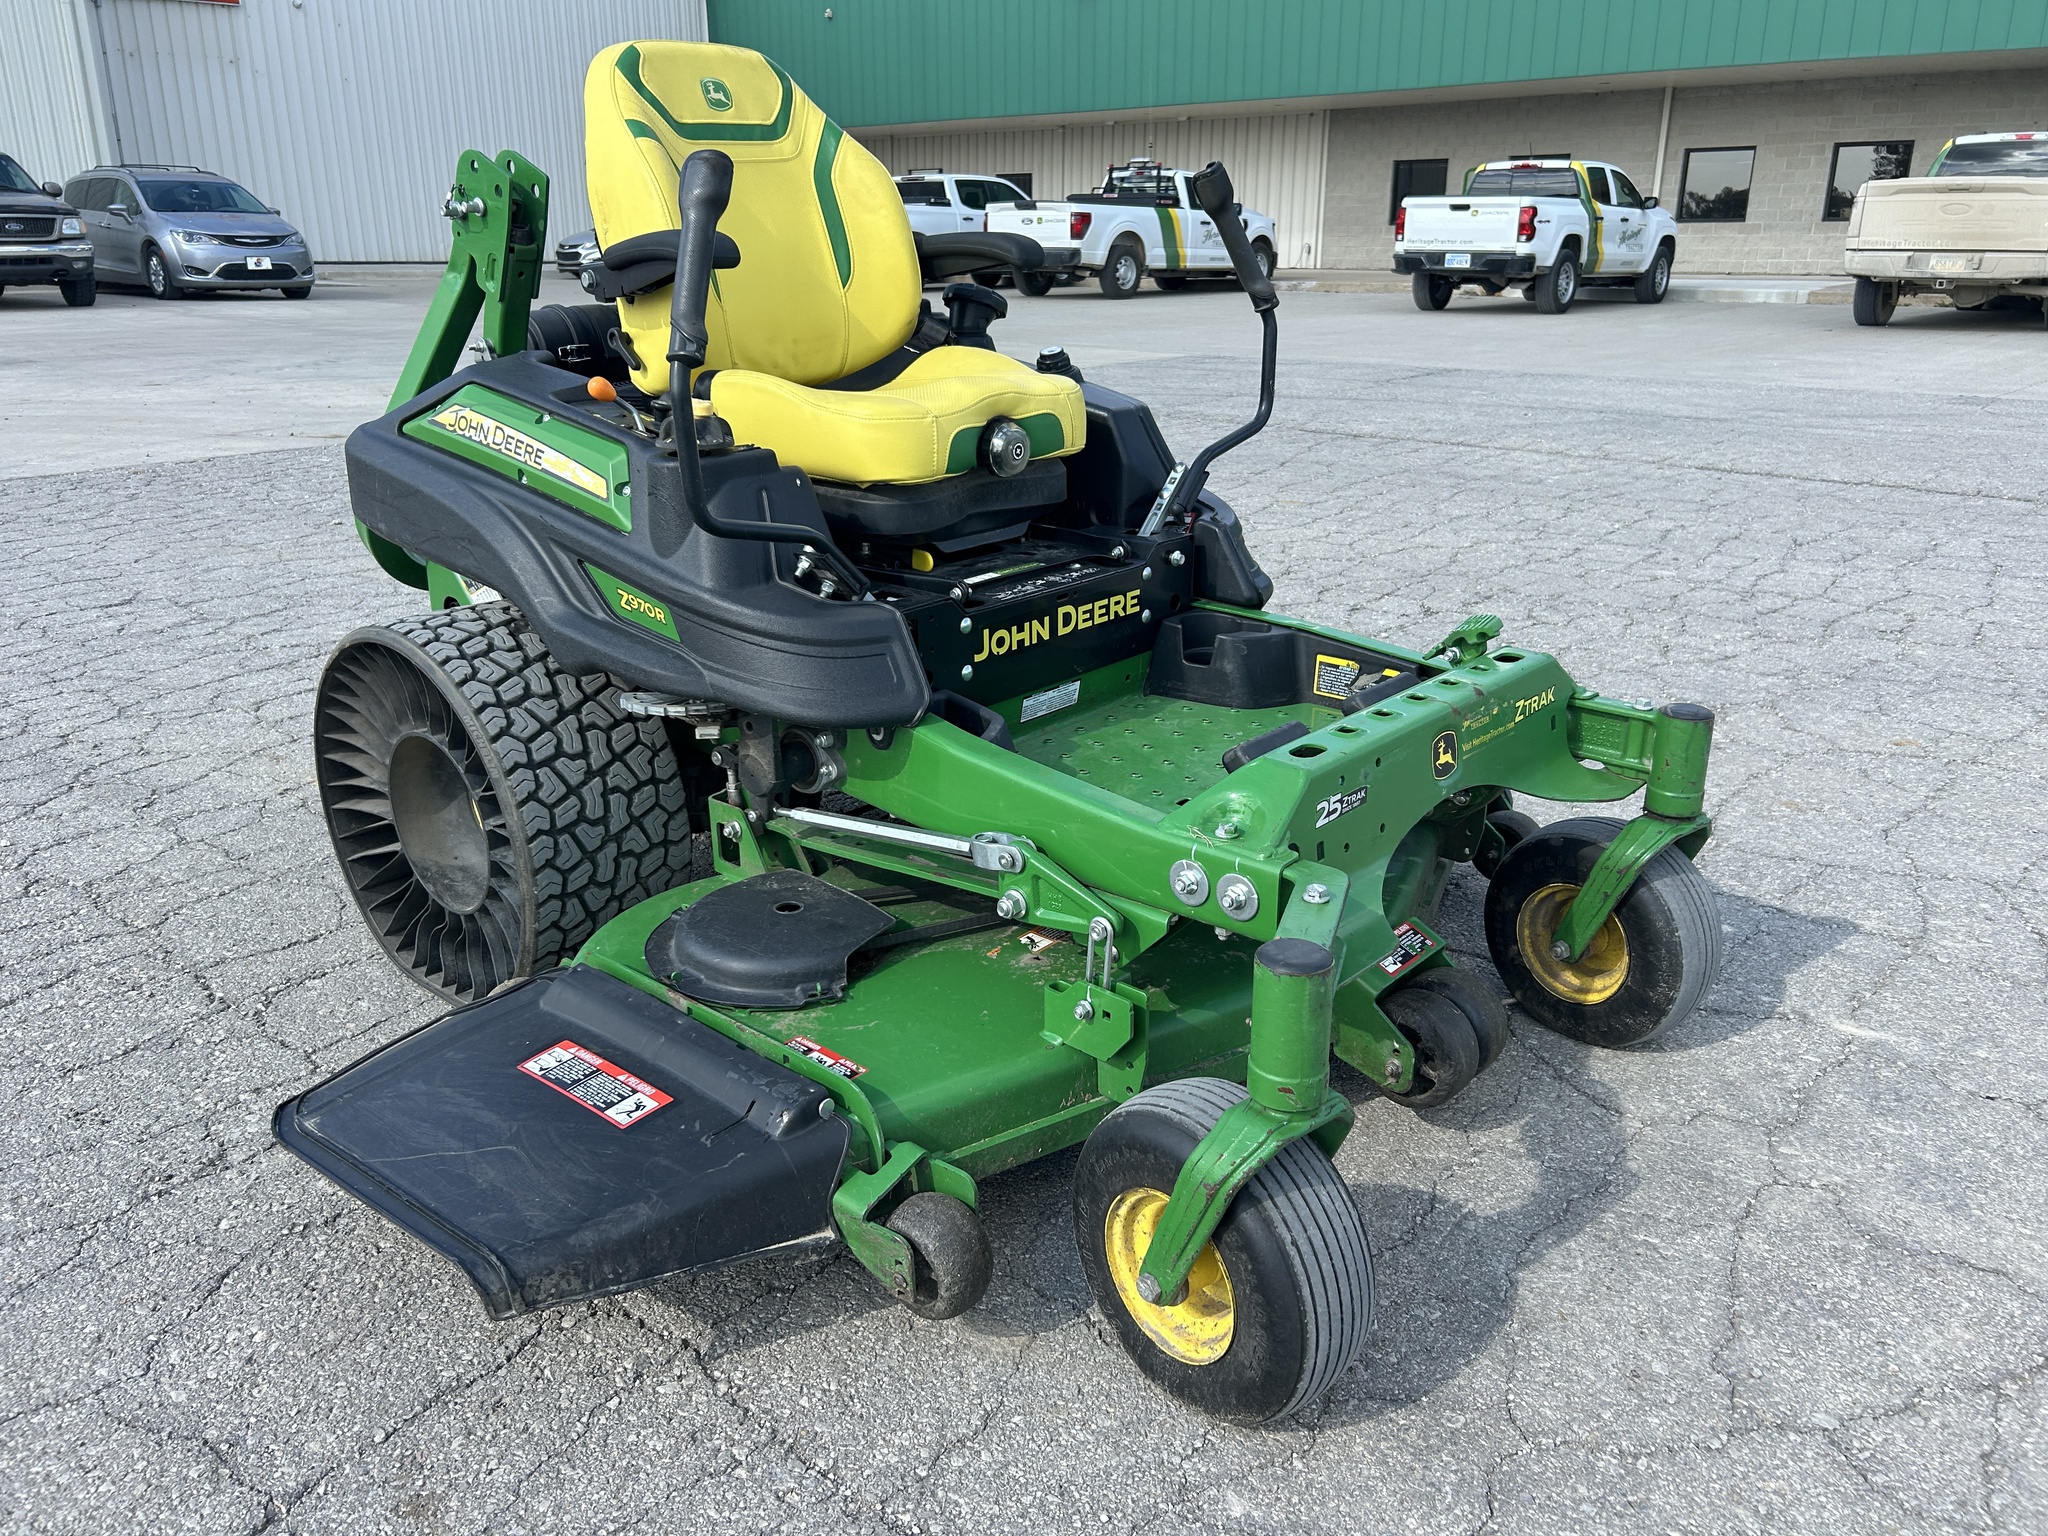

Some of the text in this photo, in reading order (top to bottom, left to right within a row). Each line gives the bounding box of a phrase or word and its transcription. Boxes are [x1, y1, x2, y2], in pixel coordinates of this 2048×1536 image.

[1407, 238, 1474, 246] HeritageTractor.com
[448, 411, 545, 466] JOHN DEERE
[616, 587, 667, 625] Z970R
[974, 588, 1141, 662] JOHN DEERE
[1514, 685, 1556, 724] ZTRAK
[463, 714, 500, 779] MICHELIN
[1473, 721, 1515, 747] HeritageTractor.com
[1315, 792, 1342, 829] 25
[1342, 788, 1366, 808] ZTRAK
[574, 1048, 603, 1066] DANGER
[624, 1075, 657, 1096] PELIGRO
